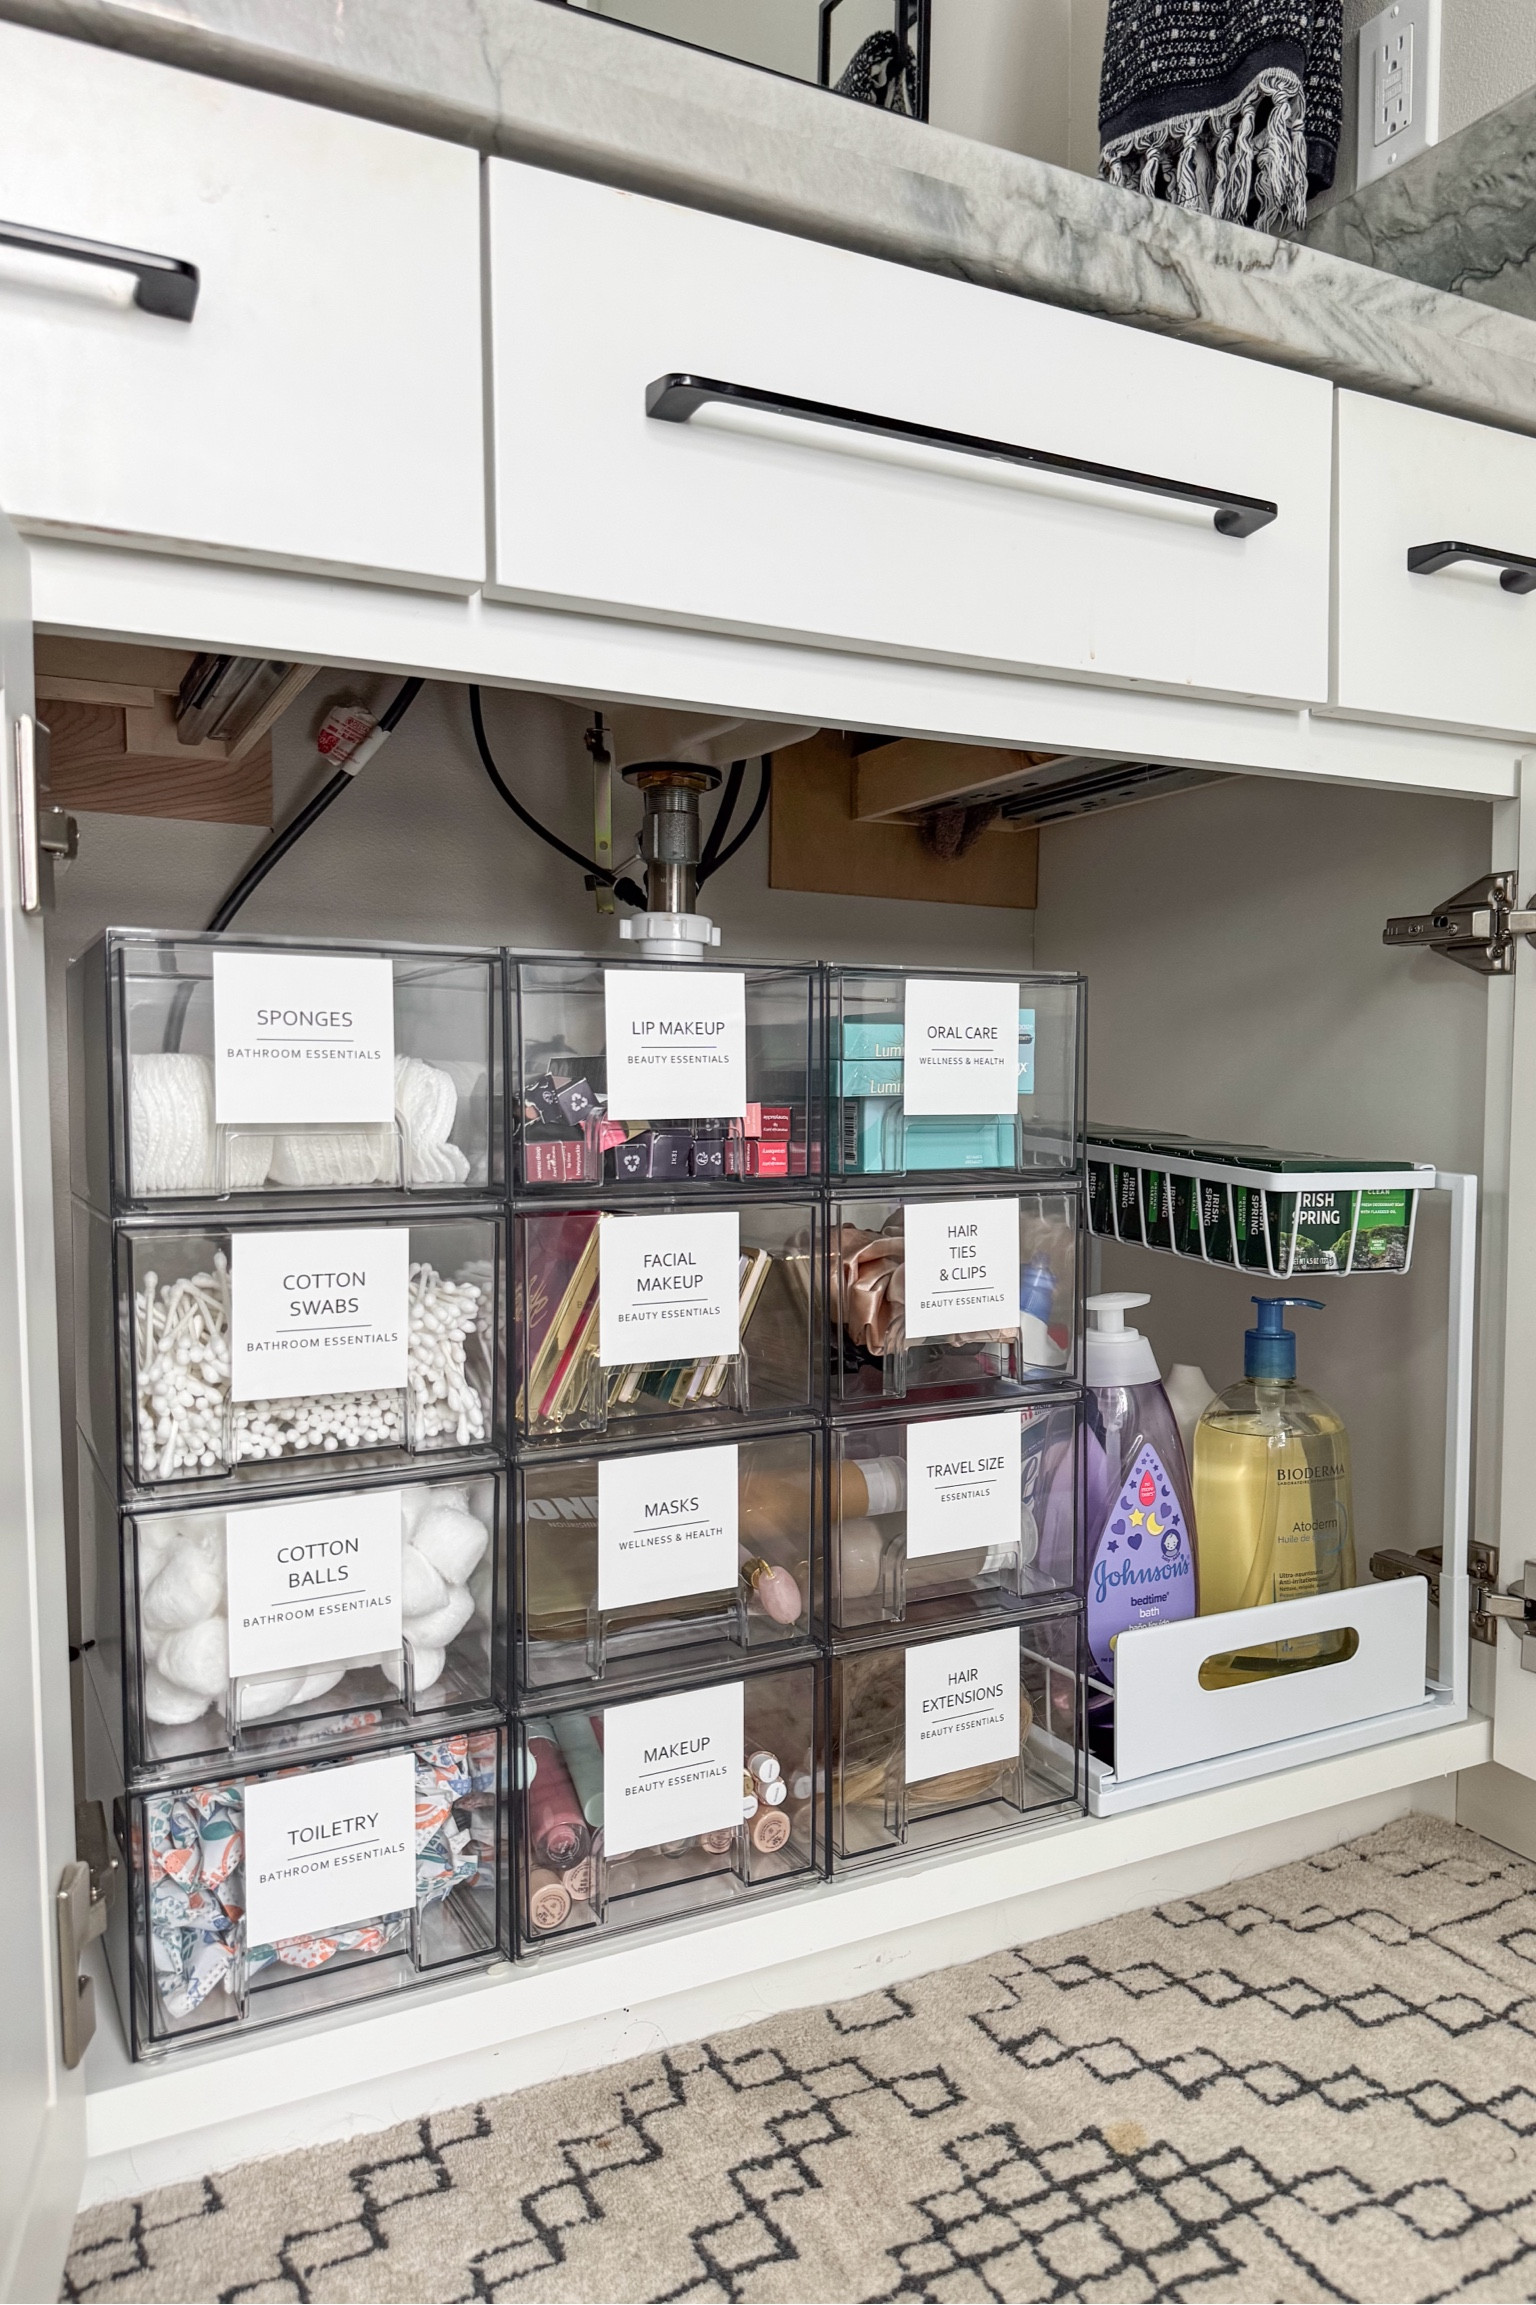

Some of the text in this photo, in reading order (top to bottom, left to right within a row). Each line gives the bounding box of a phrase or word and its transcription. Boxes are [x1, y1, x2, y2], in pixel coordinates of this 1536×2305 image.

[257, 1009, 353, 1028] SPONGES
[632, 1021, 726, 1036] LIP MAKEUP
[927, 1025, 998, 1040] ORAL CARE
[227, 1048, 381, 1060] BATHROOM ESSENTIALS
[627, 1055, 730, 1064] BEAUTY ESSENTIALS
[919, 1057, 1005, 1066] WELLNESS & HEALTH
[1089, 1171, 1097, 1199] IRISH
[1121, 1171, 1130, 1208] SPRING
[1128, 1176, 1136, 1205] IRISH
[1203, 1187, 1213, 1227] SPRING
[1211, 1193, 1220, 1223] IRISH
[1250, 1194, 1260, 1236] SPRING
[947, 1224, 978, 1239] HAIR
[643, 1252, 697, 1268] FACIAL
[948, 1245, 977, 1259] TIES
[283, 1271, 366, 1291] COTTON
[637, 1274, 704, 1293] MAKEUP
[939, 1265, 987, 1282] & CLIPS
[290, 1297, 359, 1317] SWABS
[920, 1294, 1005, 1309] BEAUTY ESSENTIALS
[618, 1306, 721, 1323] BEAUTY ESSENTIALS
[247, 1332, 398, 1352] BATHROOM ESSENTIALS
[926, 1456, 1005, 1479] TRAVEL SIZE
[1277, 1463, 1345, 1481] BIODERMA
[940, 1488, 991, 1503] ESSENTIALS
[644, 1496, 699, 1518] MASKS
[1292, 1519, 1338, 1533] Atoderm
[618, 1527, 723, 1551] WELLNESS & HEALTH
[1277, 1535, 1299, 1544] Huile
[1300, 1534, 1311, 1542] de
[277, 1537, 359, 1564] COTTON
[288, 1565, 349, 1589] BALLS
[1093, 1553, 1189, 1604] Johnson's
[243, 1595, 392, 1628] BATHROOM ESSENTIALS
[1138, 1605, 1160, 1619] bath
[948, 1668, 979, 1686] HAIR
[922, 1683, 1004, 1714] EXTENSIONS
[920, 1713, 1005, 1740] BEAUTY ESSENTIALS
[644, 1736, 711, 1764] MAKEUP
[625, 1766, 727, 1797] BEAUTY ESSENTIALS
[287, 1812, 379, 1846] TOILETRY
[259, 1842, 405, 1884] BATHROOM ESSENTIALS
